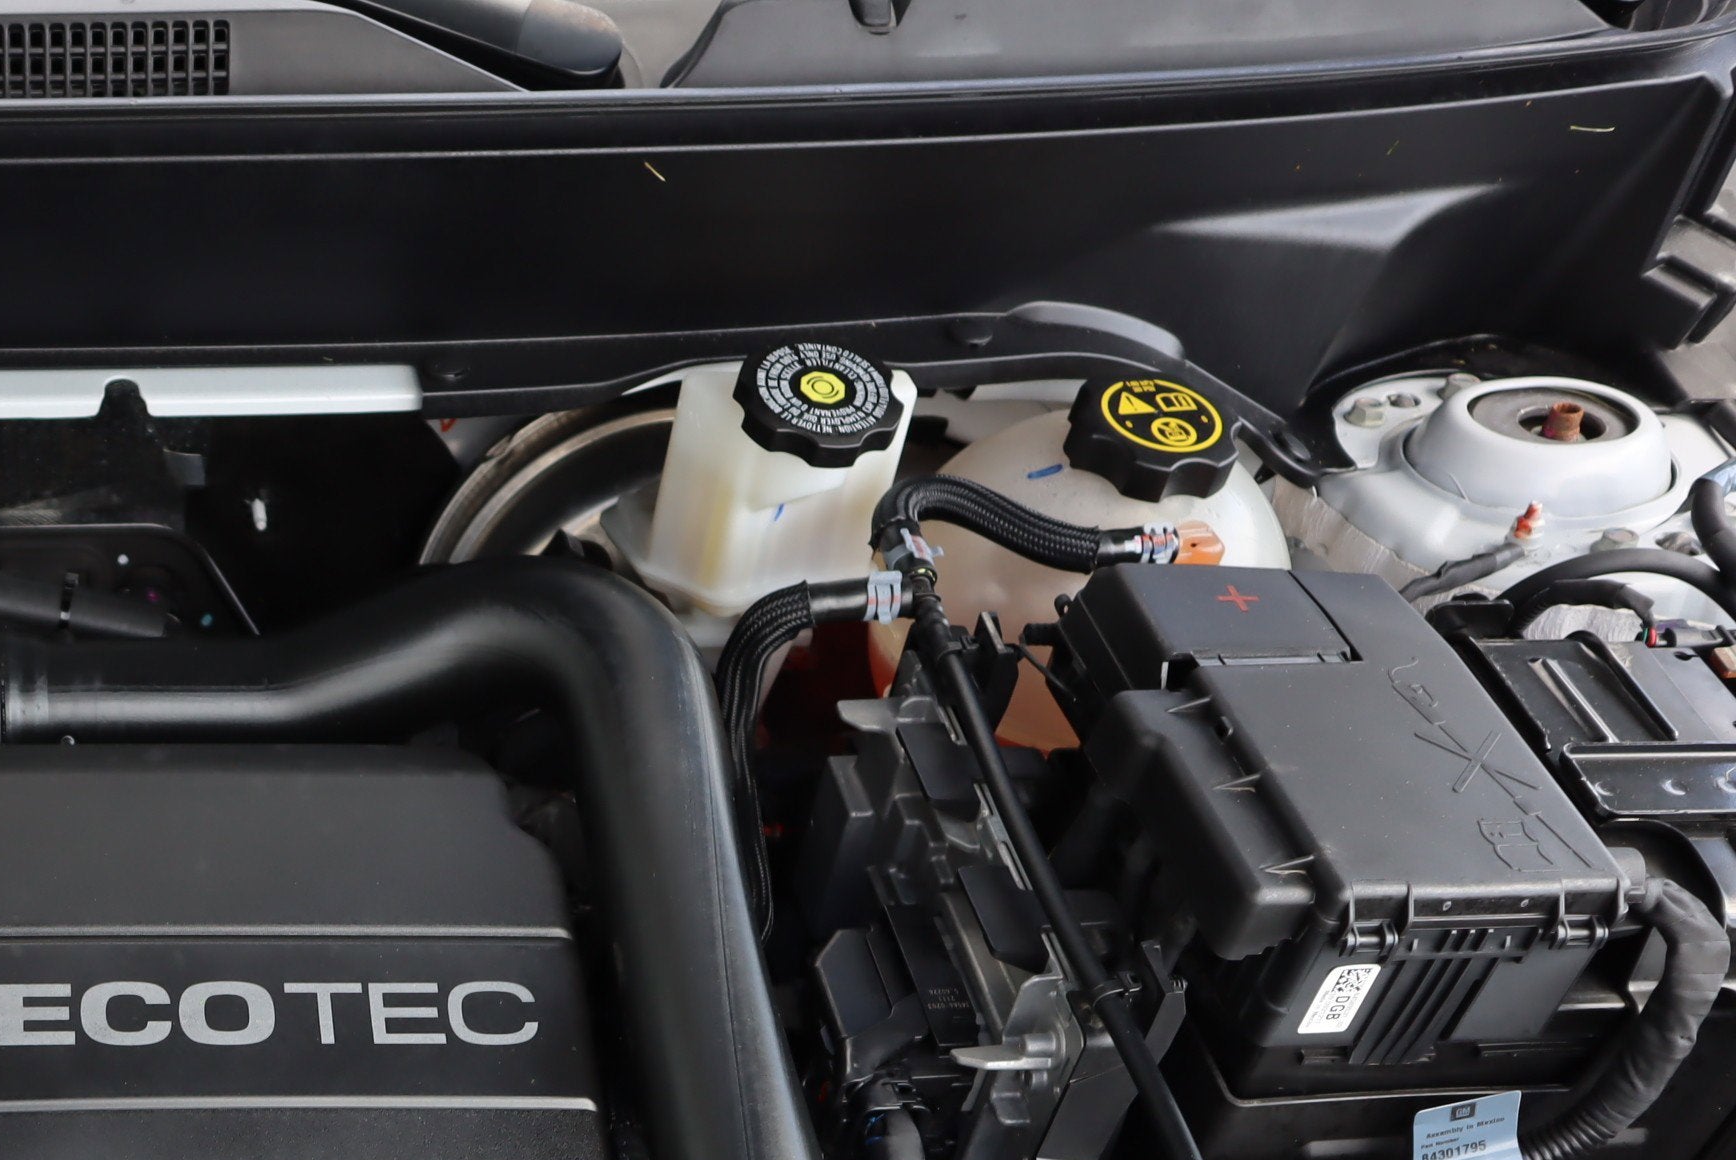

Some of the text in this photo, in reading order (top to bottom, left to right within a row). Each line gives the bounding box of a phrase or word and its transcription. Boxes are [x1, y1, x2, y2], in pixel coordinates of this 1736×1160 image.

[1326, 996, 1350, 1020] DGB
[1426, 1127, 1463, 1139] Assembly
[1476, 1116, 1505, 1128] Mexico
